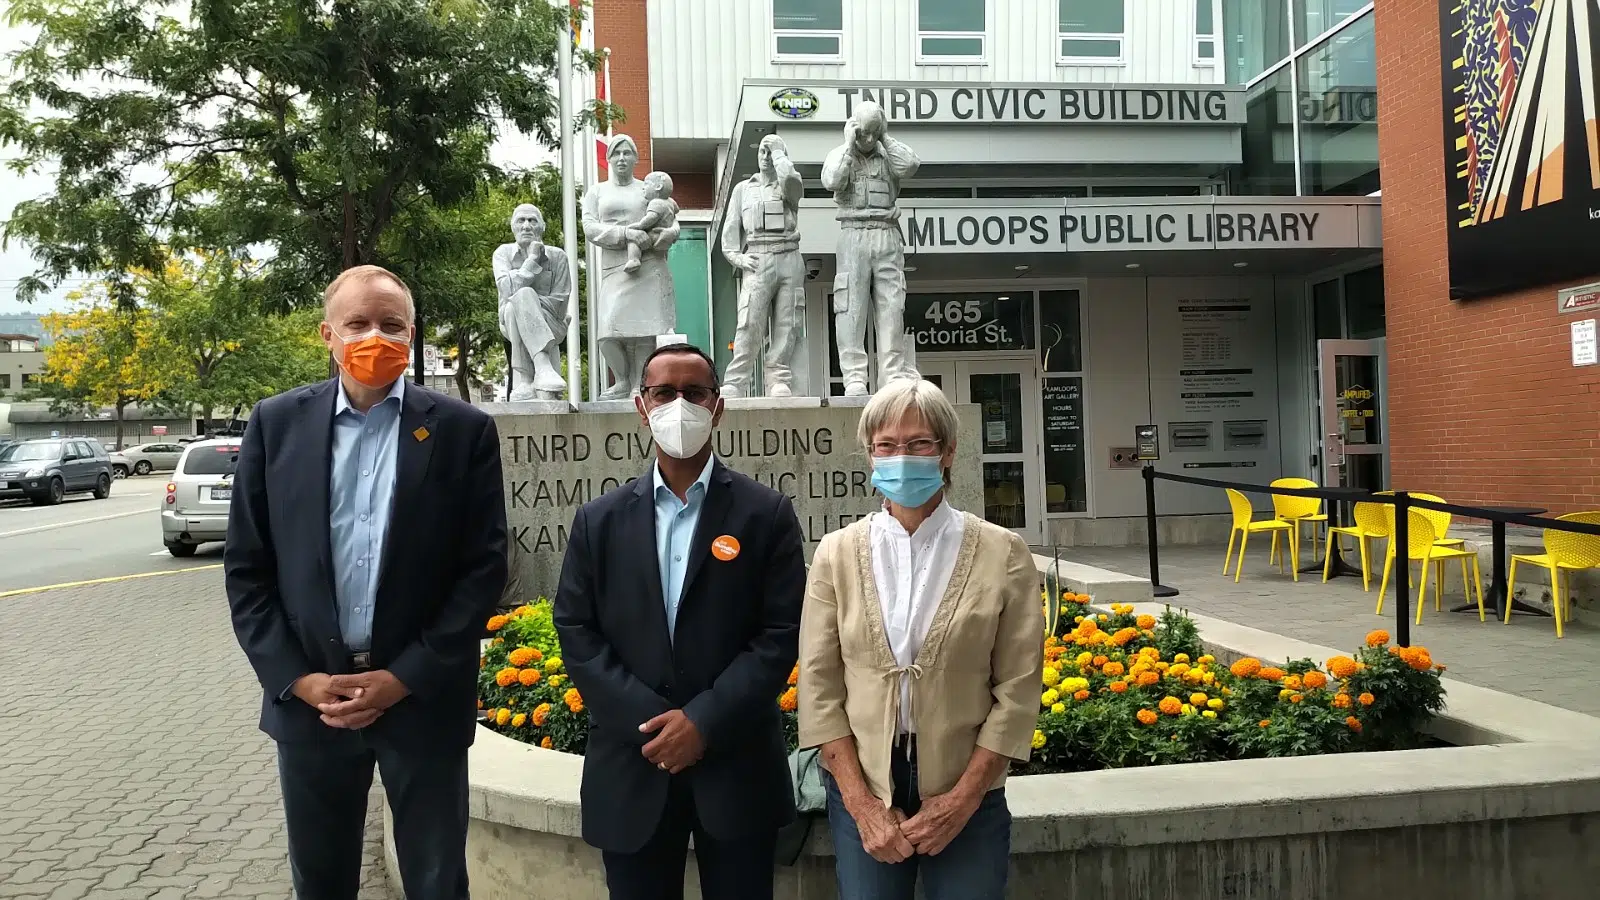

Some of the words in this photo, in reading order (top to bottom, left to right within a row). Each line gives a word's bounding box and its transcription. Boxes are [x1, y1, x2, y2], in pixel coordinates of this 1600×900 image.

[776, 97, 812, 109] TNRD
[951, 88, 1046, 120] CIVIC
[1060, 89, 1228, 121] BUILDING
[897, 215, 1049, 247] MLOOPS
[1059, 213, 1177, 245] PUBLIC
[1188, 212, 1320, 243] LIBRARY
[925, 300, 982, 324] 465
[905, 325, 979, 345] ictoria
[984, 324, 1013, 343] St.
[507, 433, 591, 463] TNRD
[604, 432, 653, 460] CIV
[714, 427, 833, 458] UILDING
